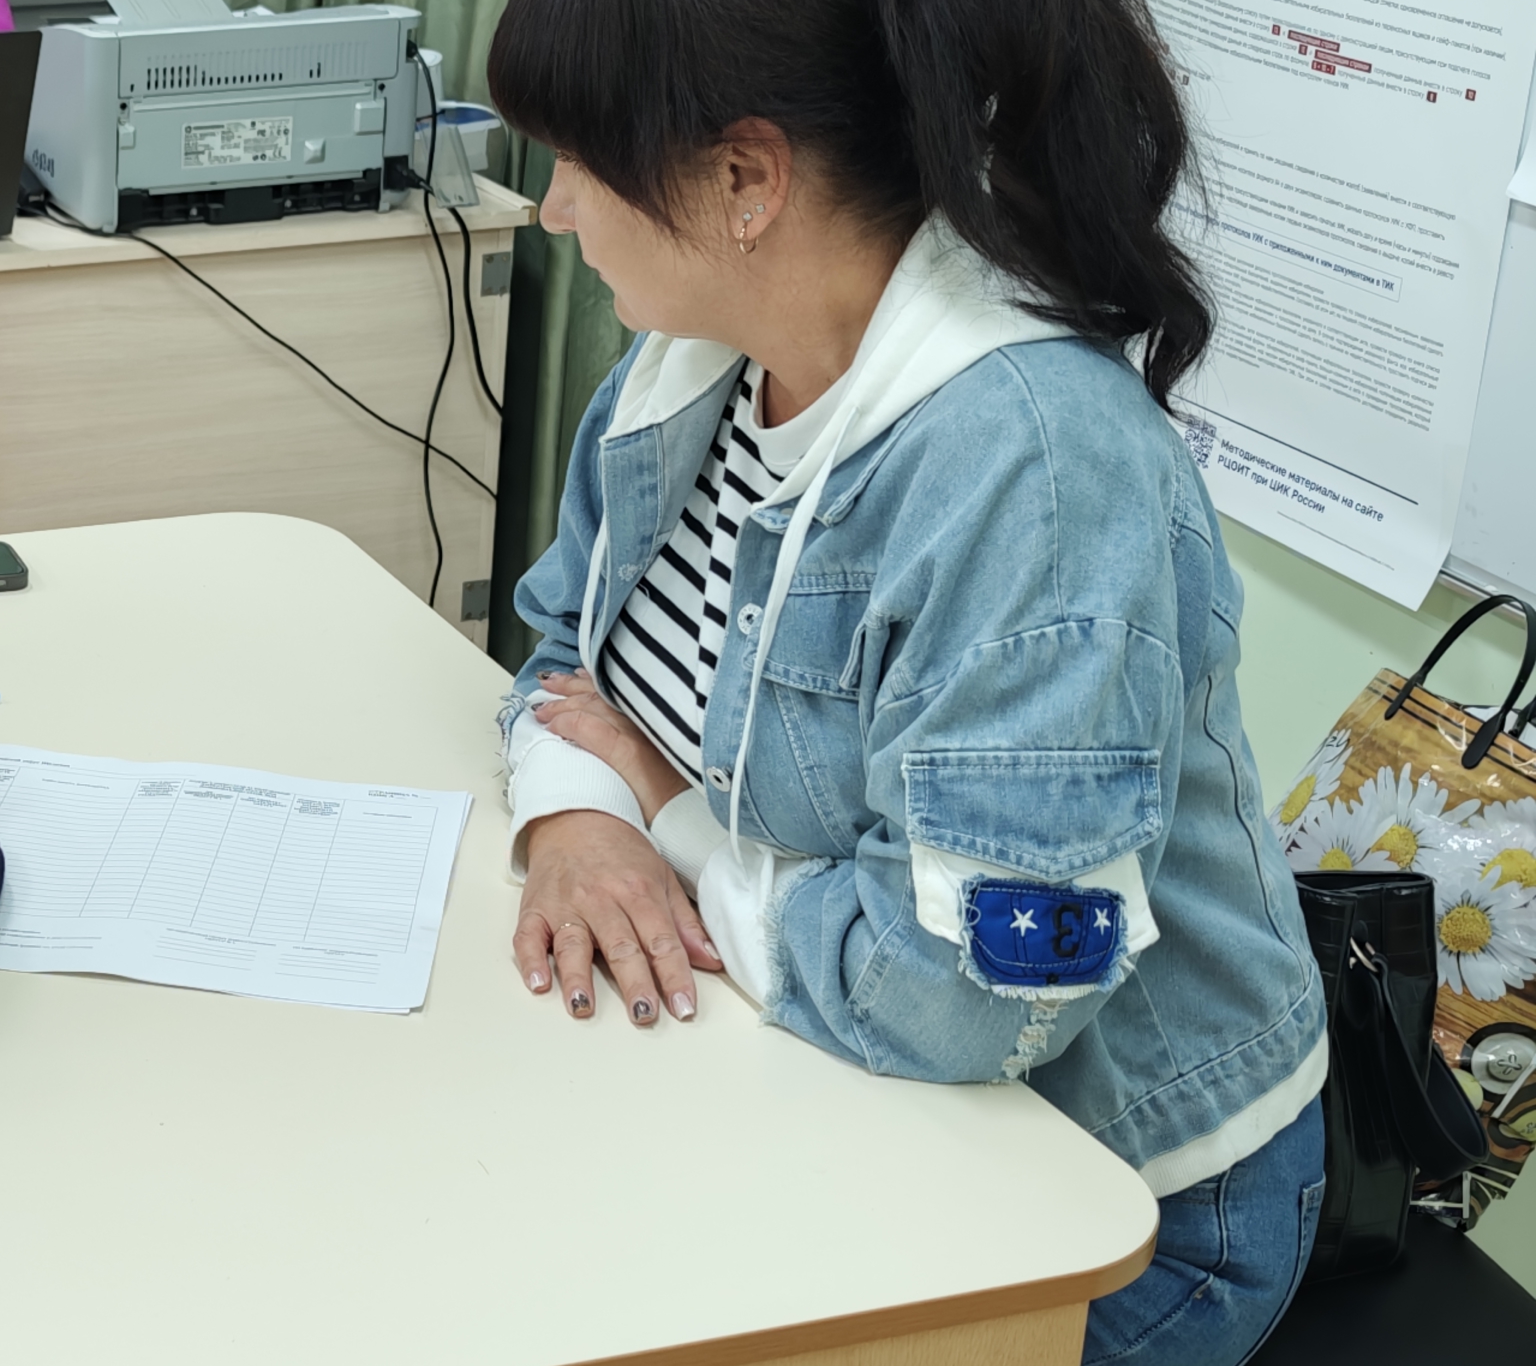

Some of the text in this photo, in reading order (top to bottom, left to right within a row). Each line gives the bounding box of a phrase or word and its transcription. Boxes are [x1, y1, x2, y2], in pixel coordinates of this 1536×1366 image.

[1217, 454, 1326, 514] РЦОИТ при ЦИК России
[1221, 439, 1384, 522] Методические материалы на сайте
